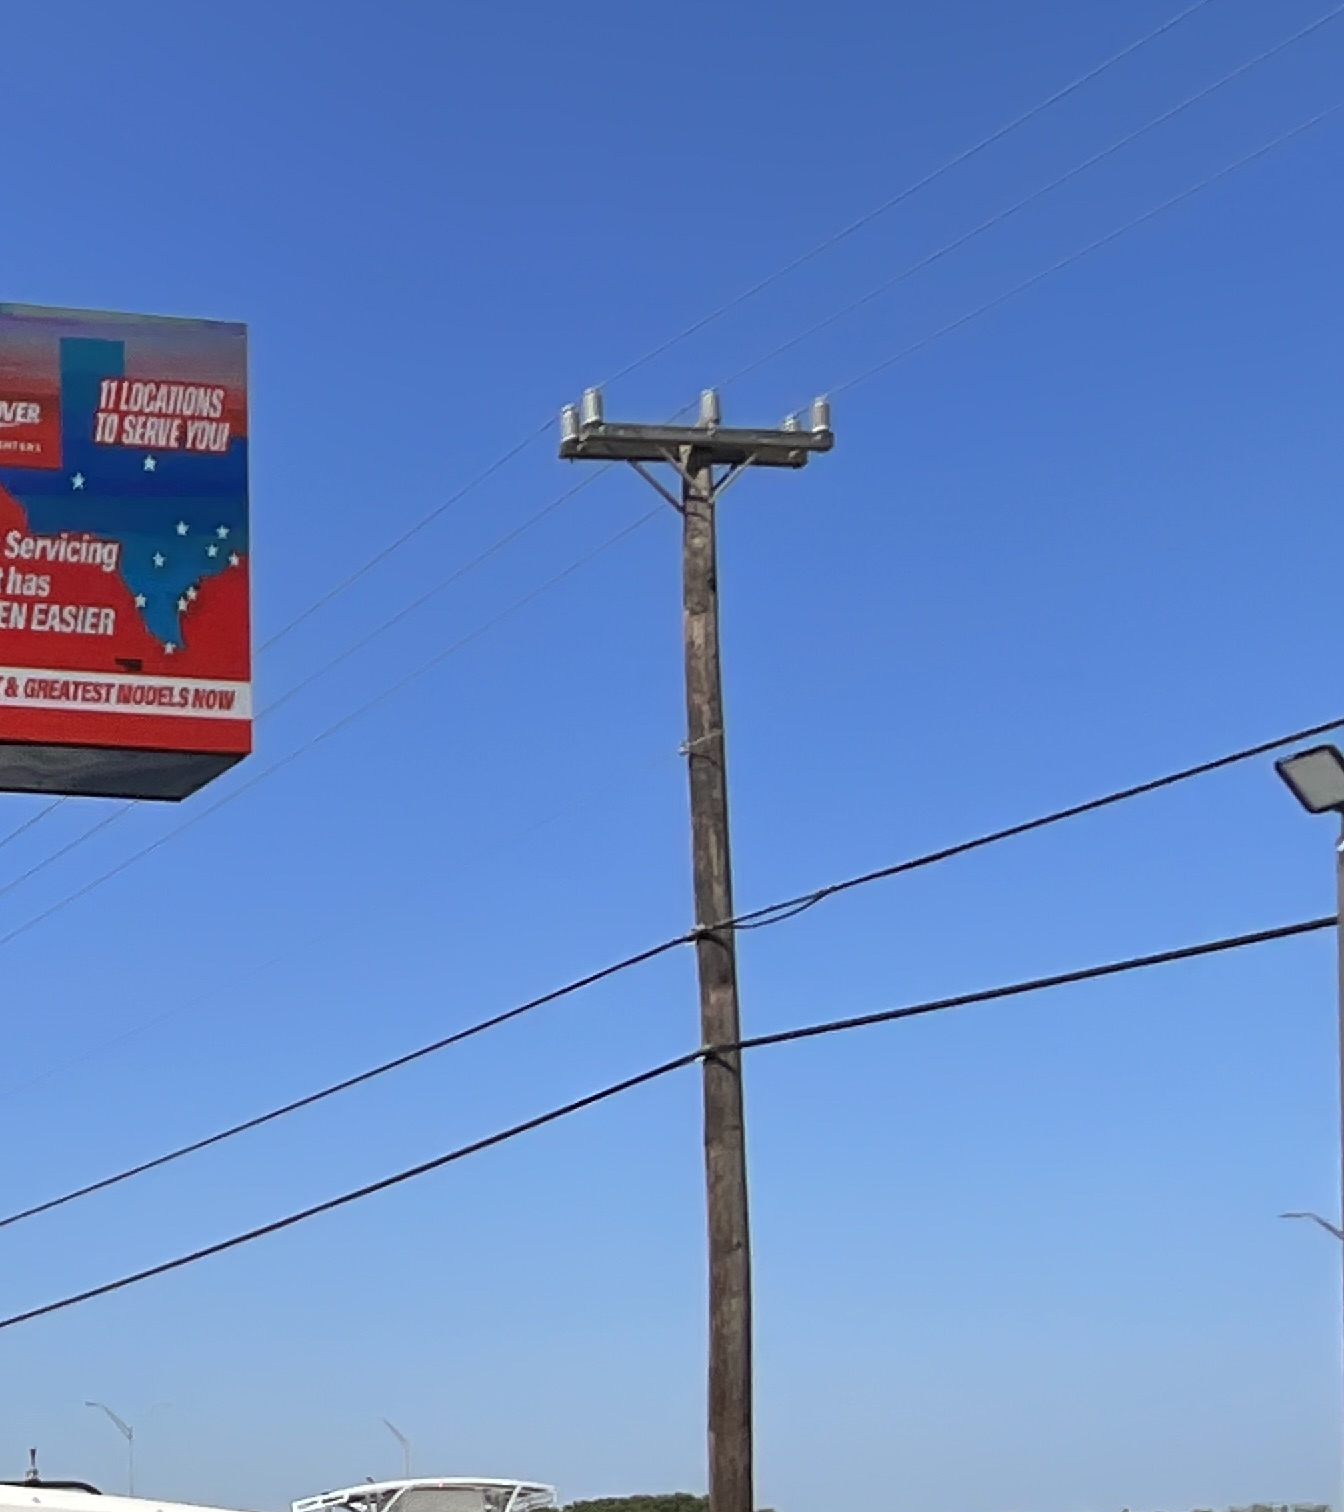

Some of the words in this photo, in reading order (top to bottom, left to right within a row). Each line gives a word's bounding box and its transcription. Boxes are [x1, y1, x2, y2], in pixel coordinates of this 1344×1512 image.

[100, 379, 118, 410] 11
[118, 380, 225, 418] LOCATIONS
[95, 411, 120, 444] TO
[122, 414, 183, 448] SERVE
[186, 419, 230, 452] YOU!
[4, 529, 120, 573] Servicing
[6, 566, 52, 598] has
[30, 602, 116, 636] EASIER
[4, 675, 19, 698] &
[24, 677, 116, 704] GREATEST
[115, 683, 191, 708] MODELS
[191, 687, 236, 711] NOW
